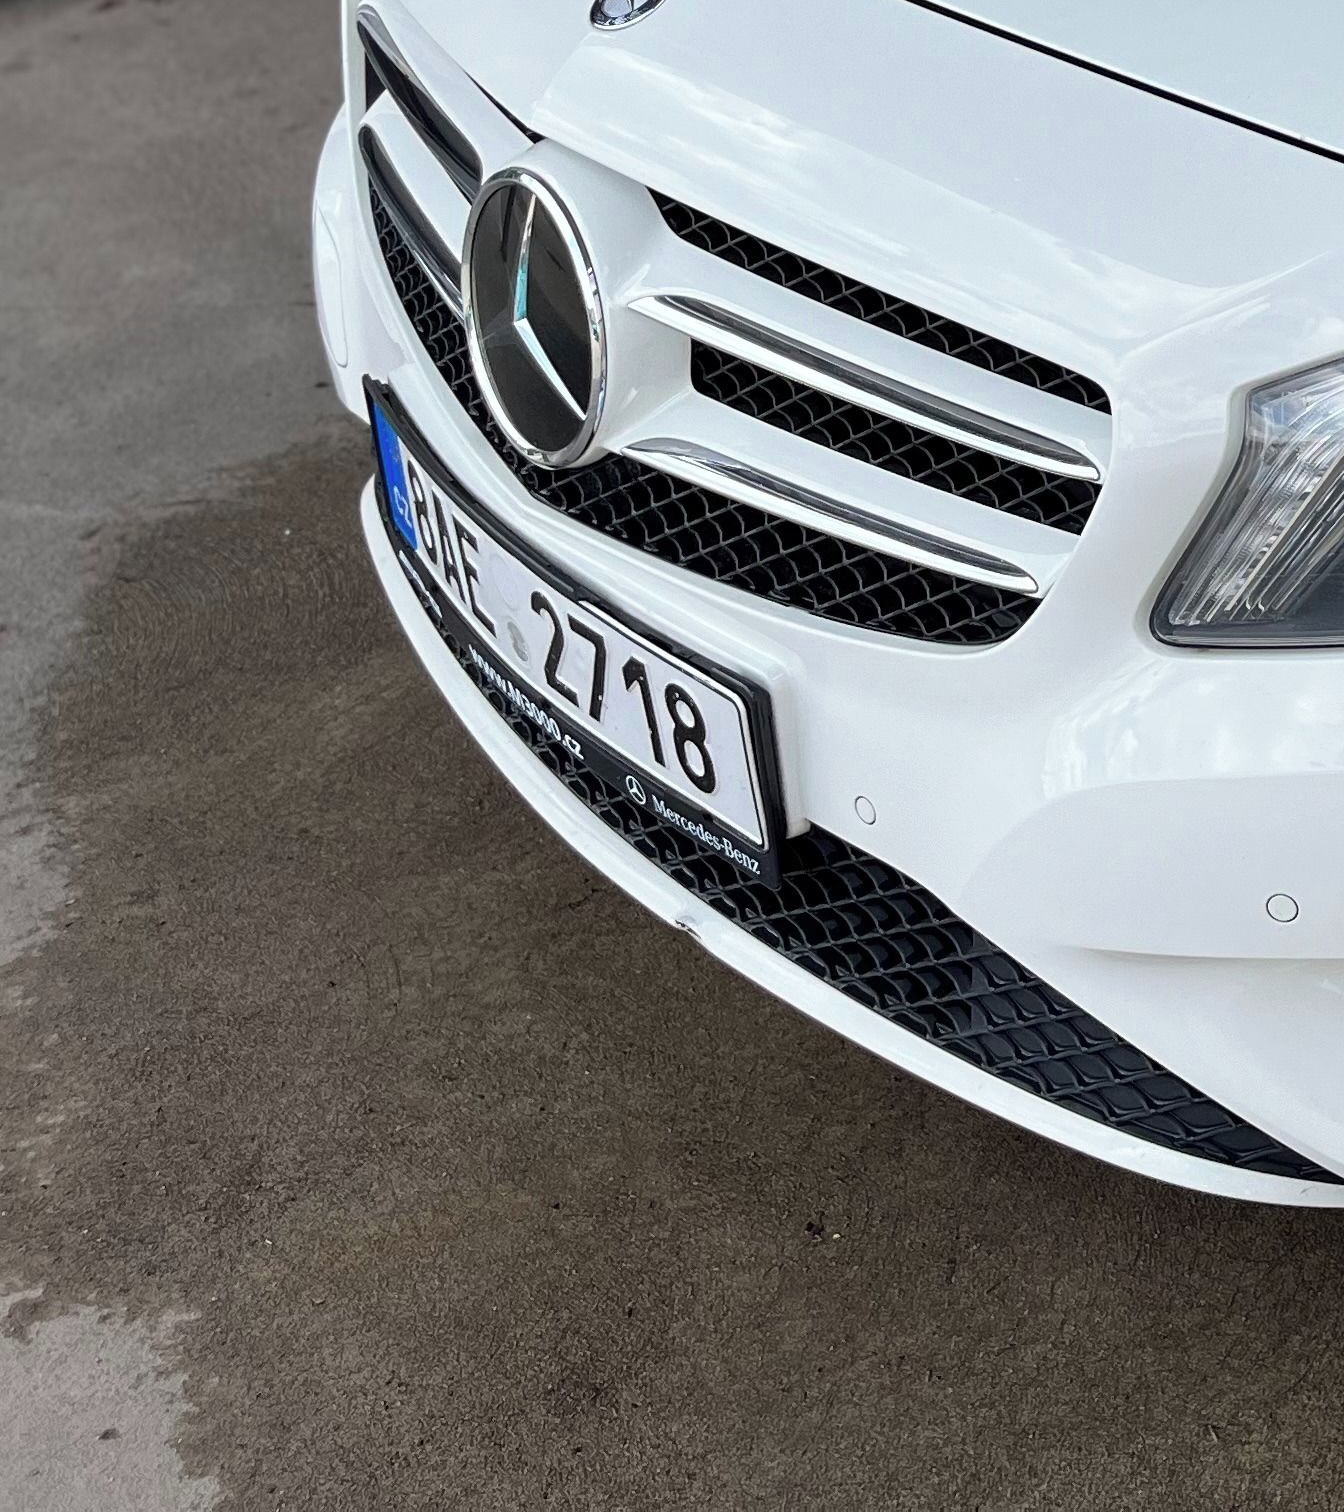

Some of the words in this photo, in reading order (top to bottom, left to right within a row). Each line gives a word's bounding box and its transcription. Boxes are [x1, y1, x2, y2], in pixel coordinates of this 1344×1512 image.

[393, 485, 413, 528] CZ
[407, 459, 497, 639] 8AE
[530, 589, 716, 794] 2718
[652, 794, 761, 875] Mercedes-Benz
